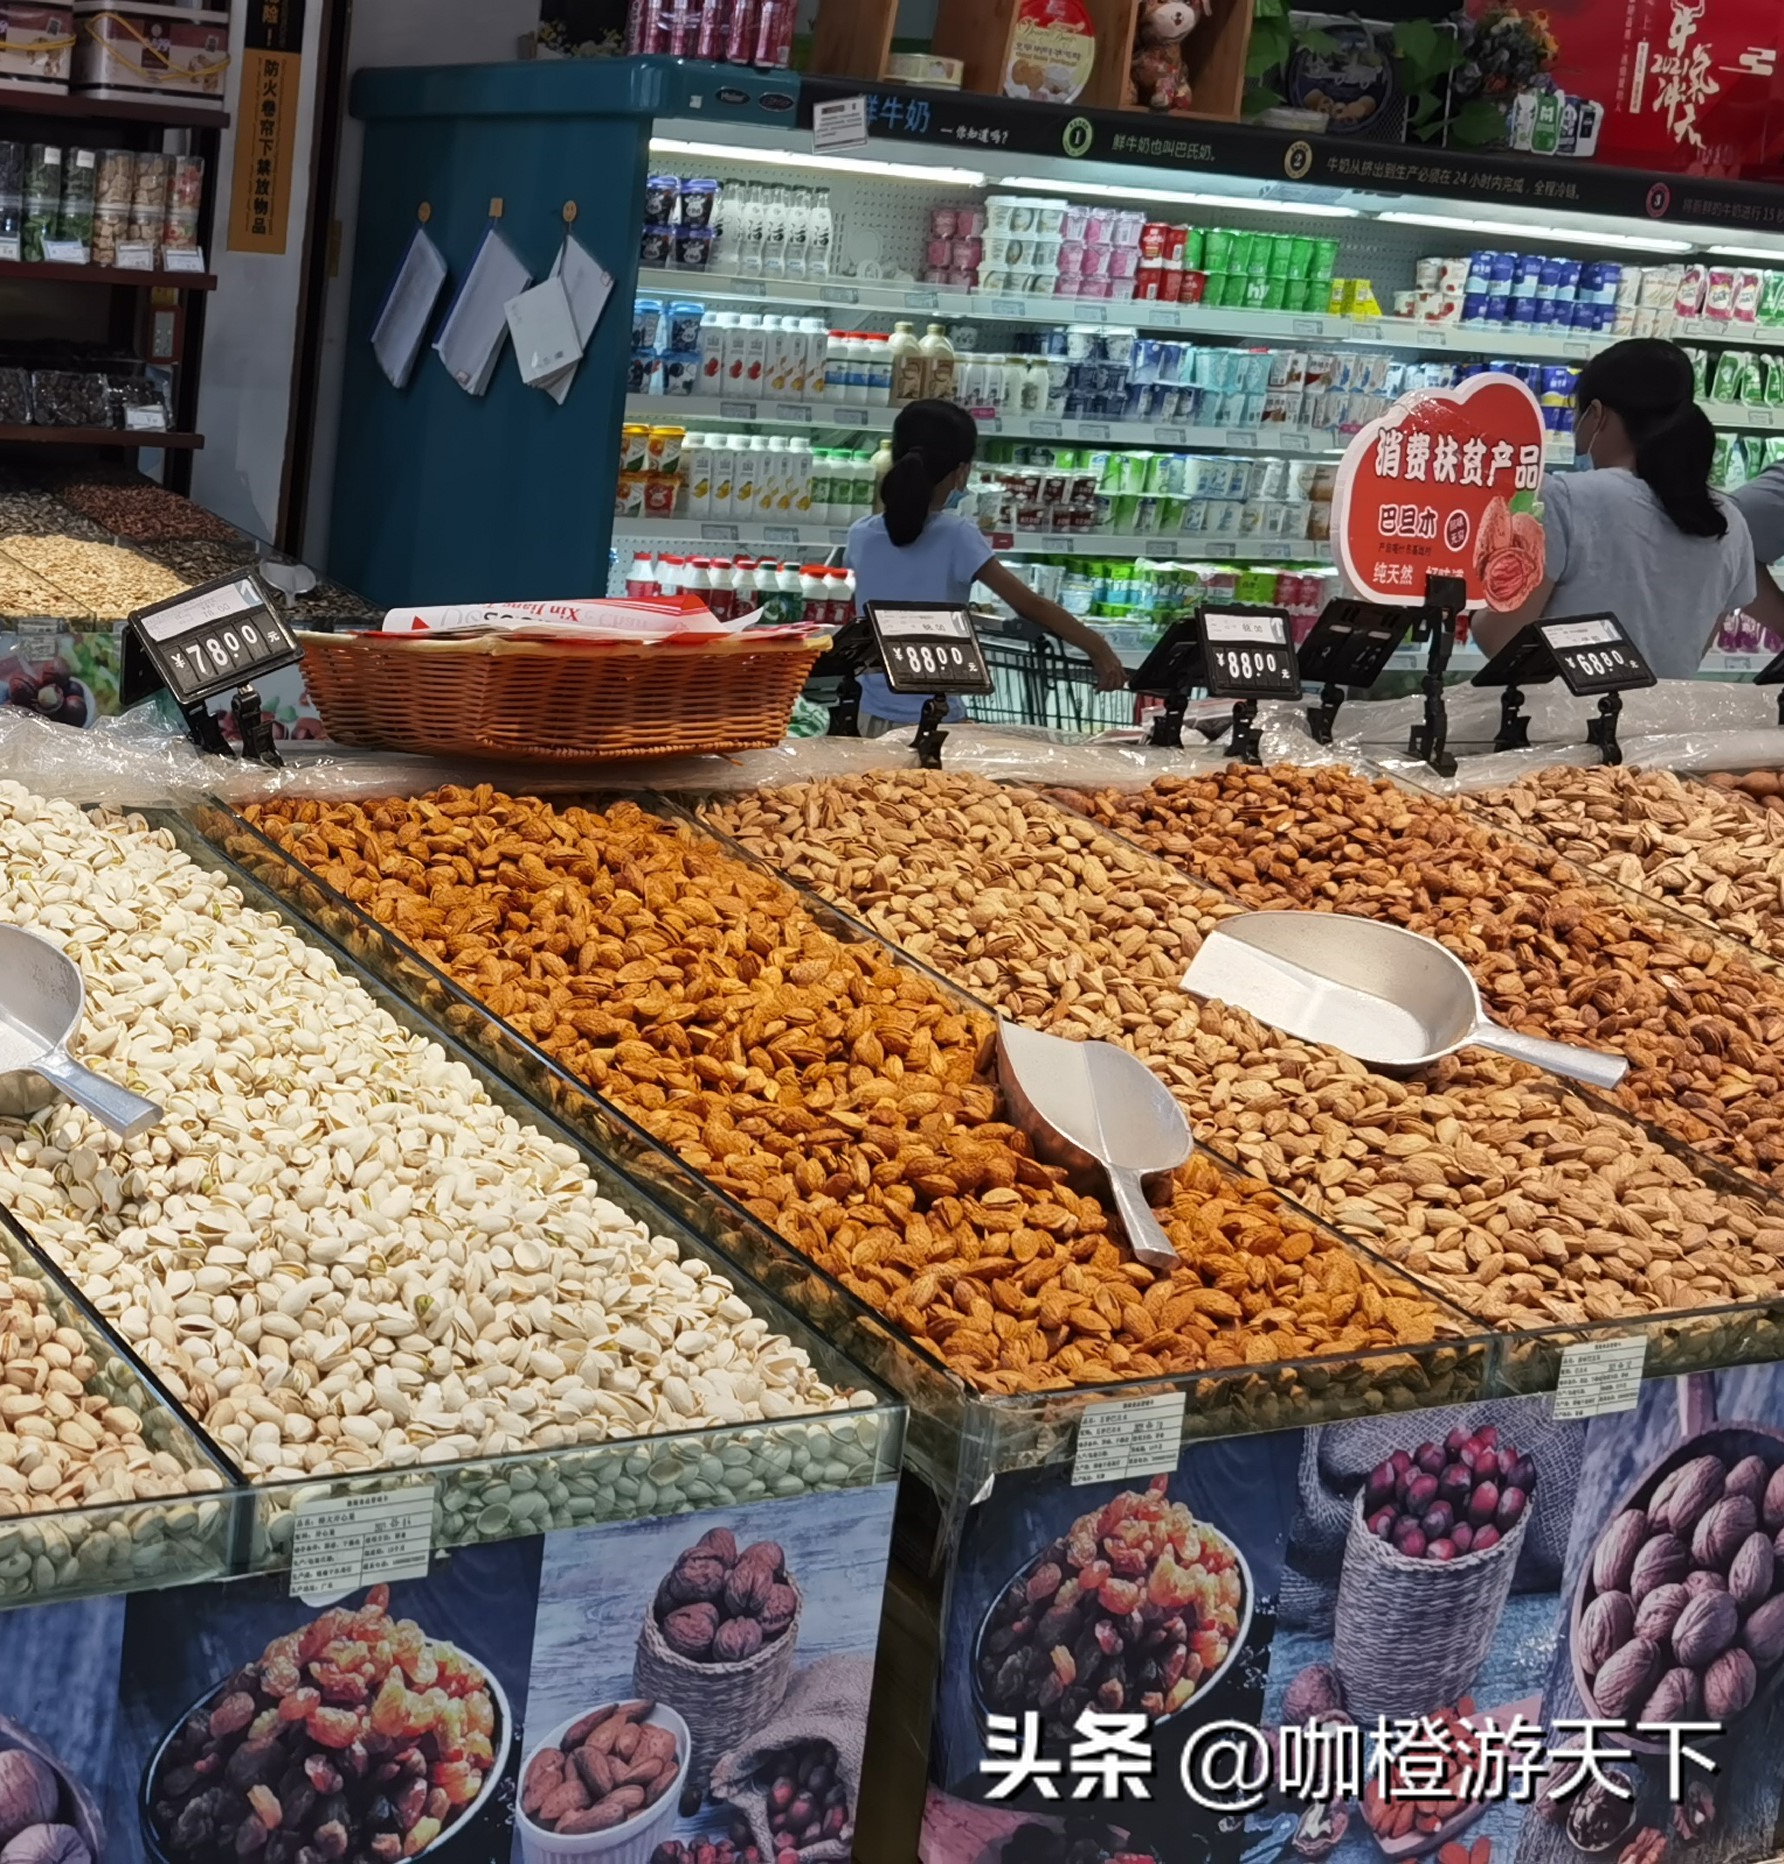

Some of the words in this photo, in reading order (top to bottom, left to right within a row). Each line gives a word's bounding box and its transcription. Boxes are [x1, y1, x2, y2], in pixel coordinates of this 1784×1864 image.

[1375, 427, 1540, 489] 消费扶贫产品
[1378, 503, 1439, 539] 巴旦木
[1373, 561, 1414, 586] 纯天然
